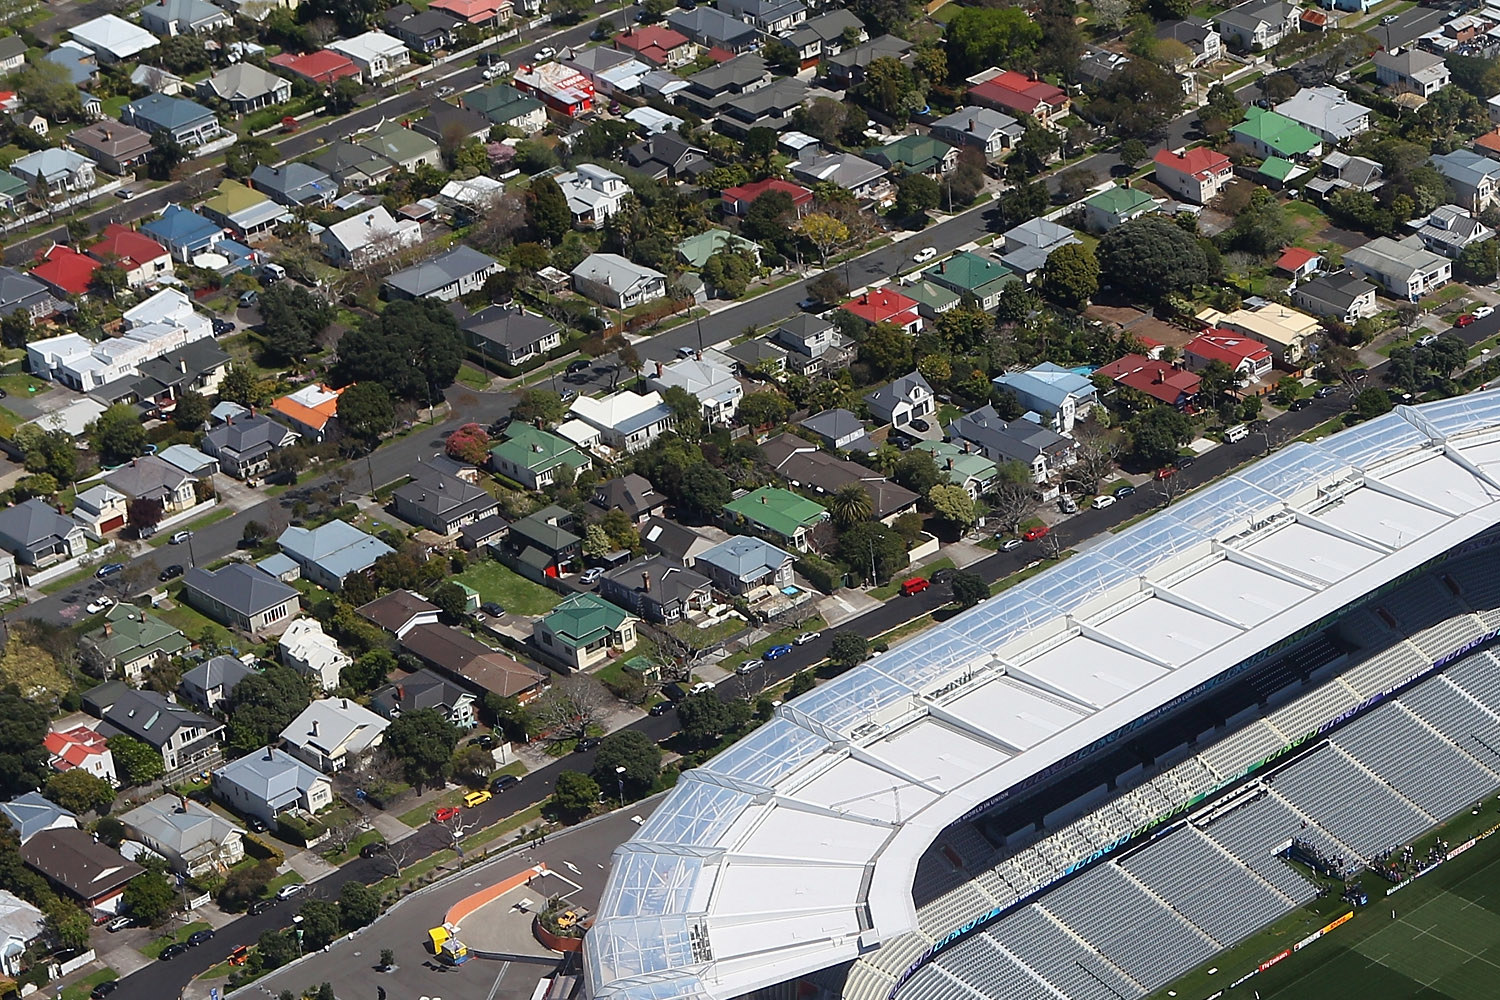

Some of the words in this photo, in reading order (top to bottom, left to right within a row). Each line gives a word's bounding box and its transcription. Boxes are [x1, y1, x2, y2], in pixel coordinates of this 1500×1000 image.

[1143, 708, 1162, 721] RUGBY
[1162, 698, 1181, 712] WORLD
[1000, 897, 1019, 911] RUGBY
[1020, 886, 1040, 900] WORLD
[1040, 879, 1052, 888] CUP
[1052, 871, 1066, 882] 2011
[1262, 962, 1270, 970] Fly
